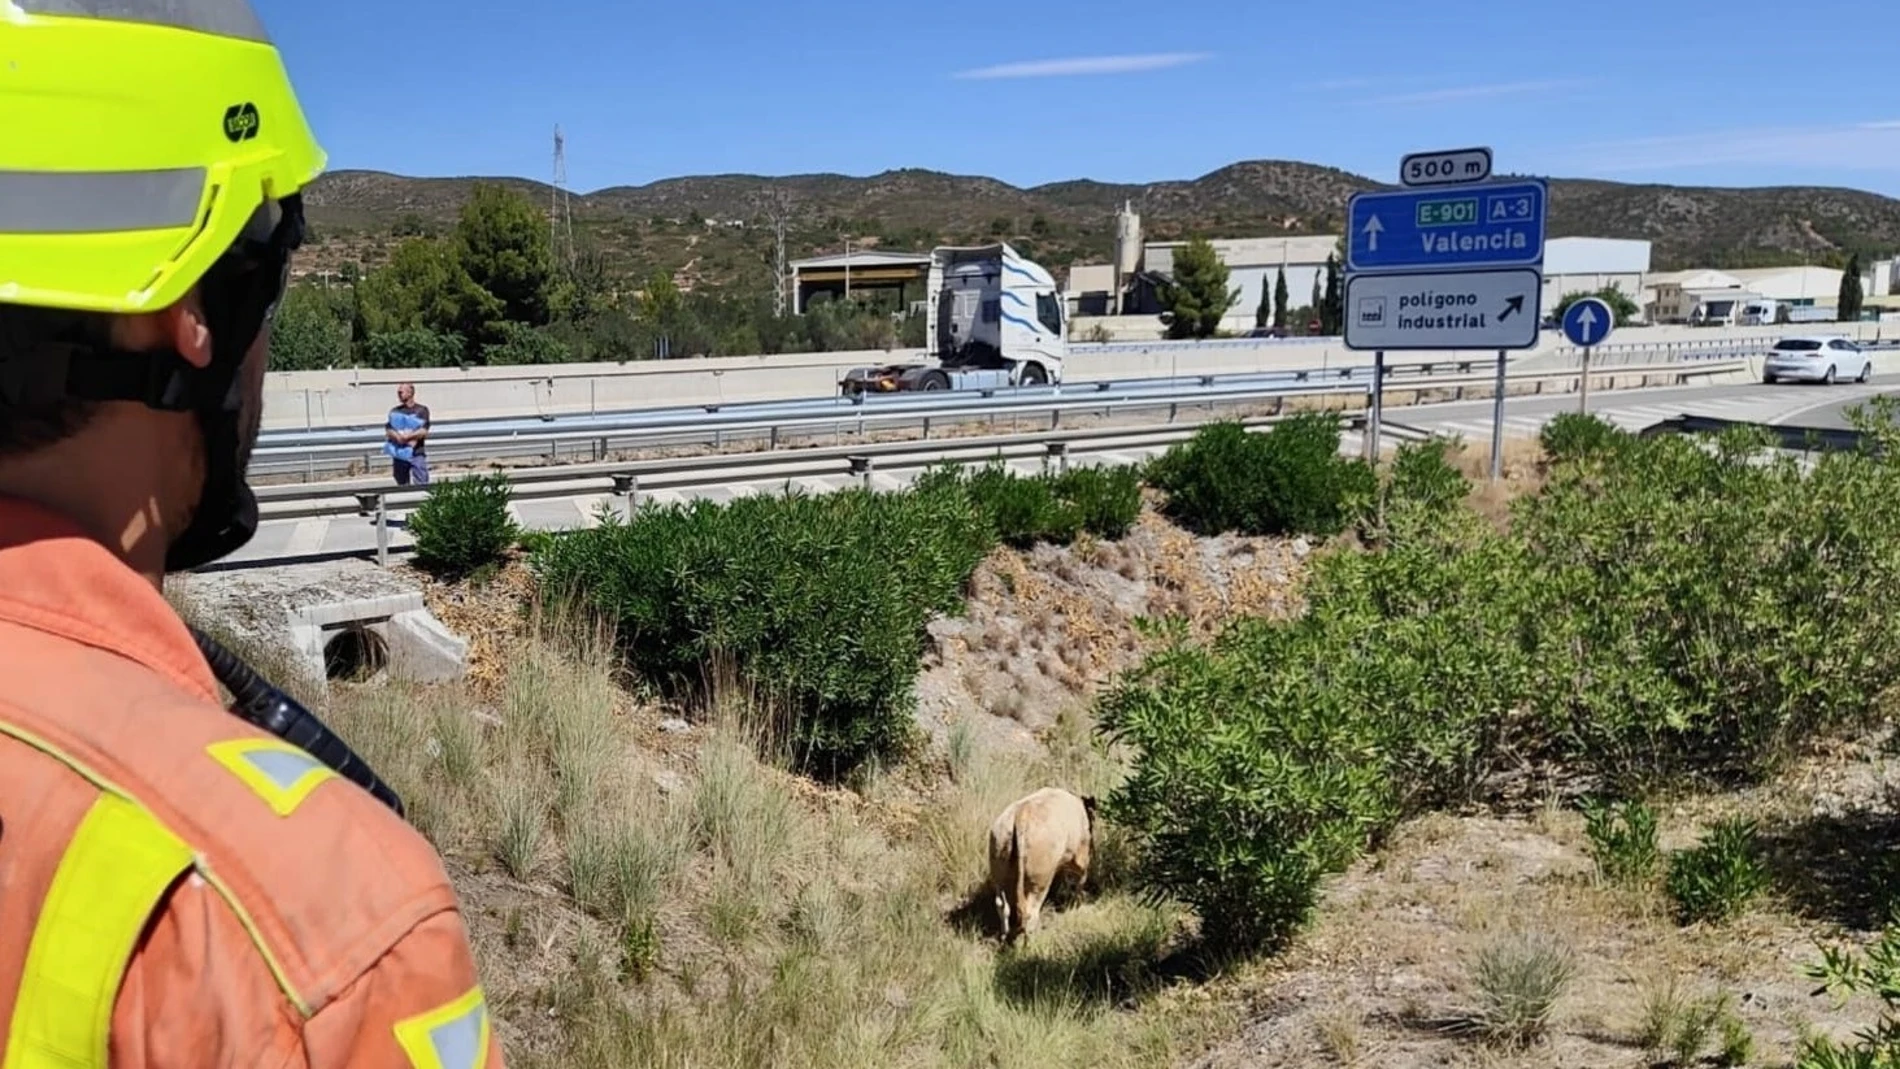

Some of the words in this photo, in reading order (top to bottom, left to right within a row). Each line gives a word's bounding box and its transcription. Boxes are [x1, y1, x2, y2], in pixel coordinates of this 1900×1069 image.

[1411, 160, 1454, 178] 500
[1465, 161, 1481, 173] m
[1420, 203, 1474, 222] E-901
[1492, 199, 1529, 218] A-3
[1421, 228, 1526, 253] Valencia
[1400, 290, 1477, 309] polígono
[1398, 313, 1486, 330] industrial
